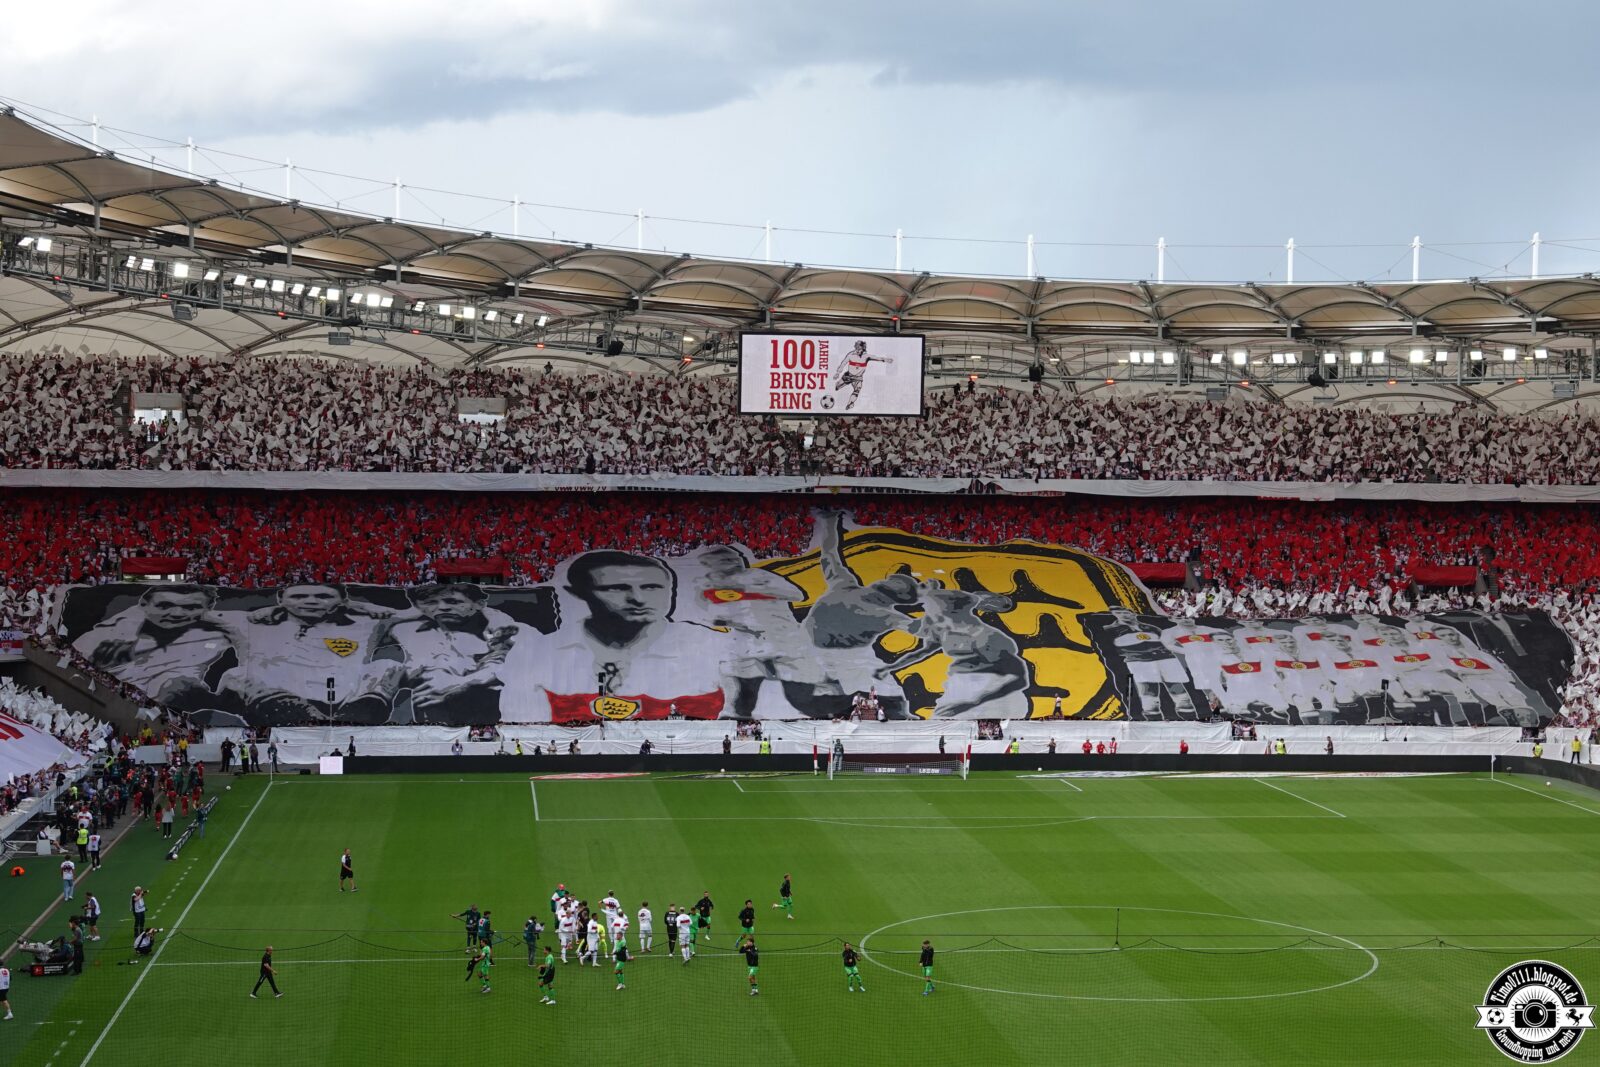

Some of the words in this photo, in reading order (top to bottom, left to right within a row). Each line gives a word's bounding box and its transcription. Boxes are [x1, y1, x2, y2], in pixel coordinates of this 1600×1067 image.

[770, 339, 815, 370] 100
[818, 339, 829, 370] JAHRE
[769, 372, 828, 390] BRUST
[769, 392, 812, 410] RING
